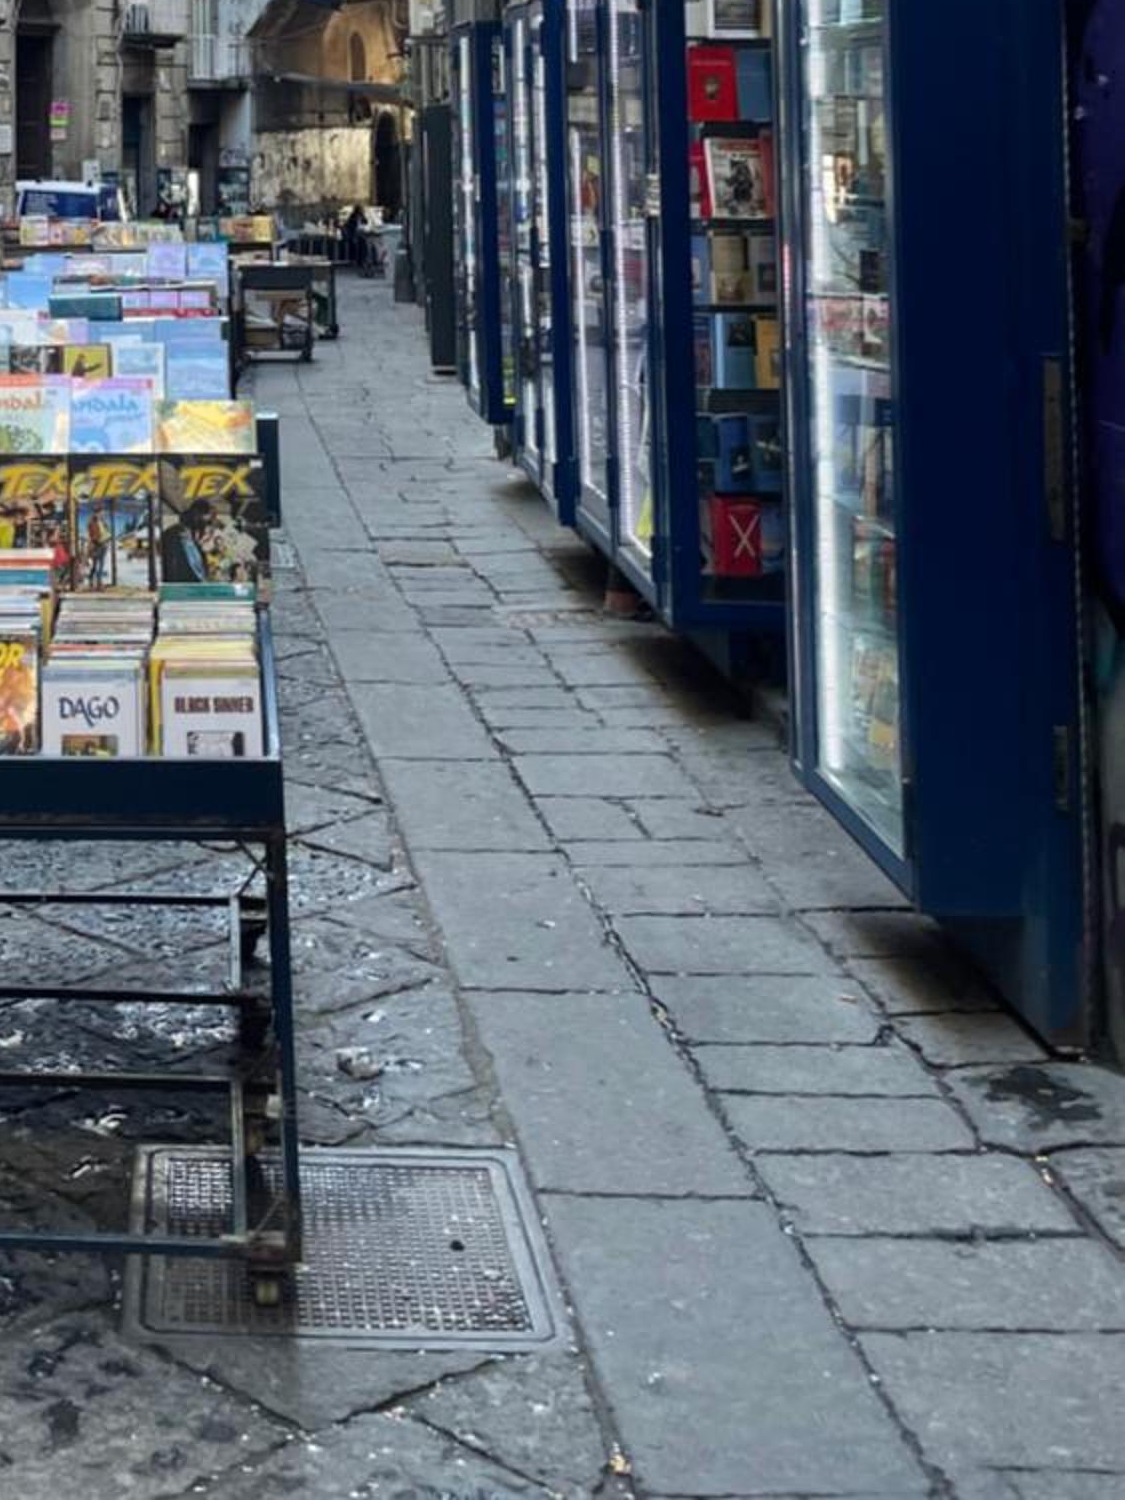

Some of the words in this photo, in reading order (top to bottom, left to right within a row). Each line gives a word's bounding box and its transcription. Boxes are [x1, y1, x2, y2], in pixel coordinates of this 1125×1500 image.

[87, 461, 156, 499] TEX
[178, 464, 255, 499] TEX
[59, 696, 120, 727] DAGO
